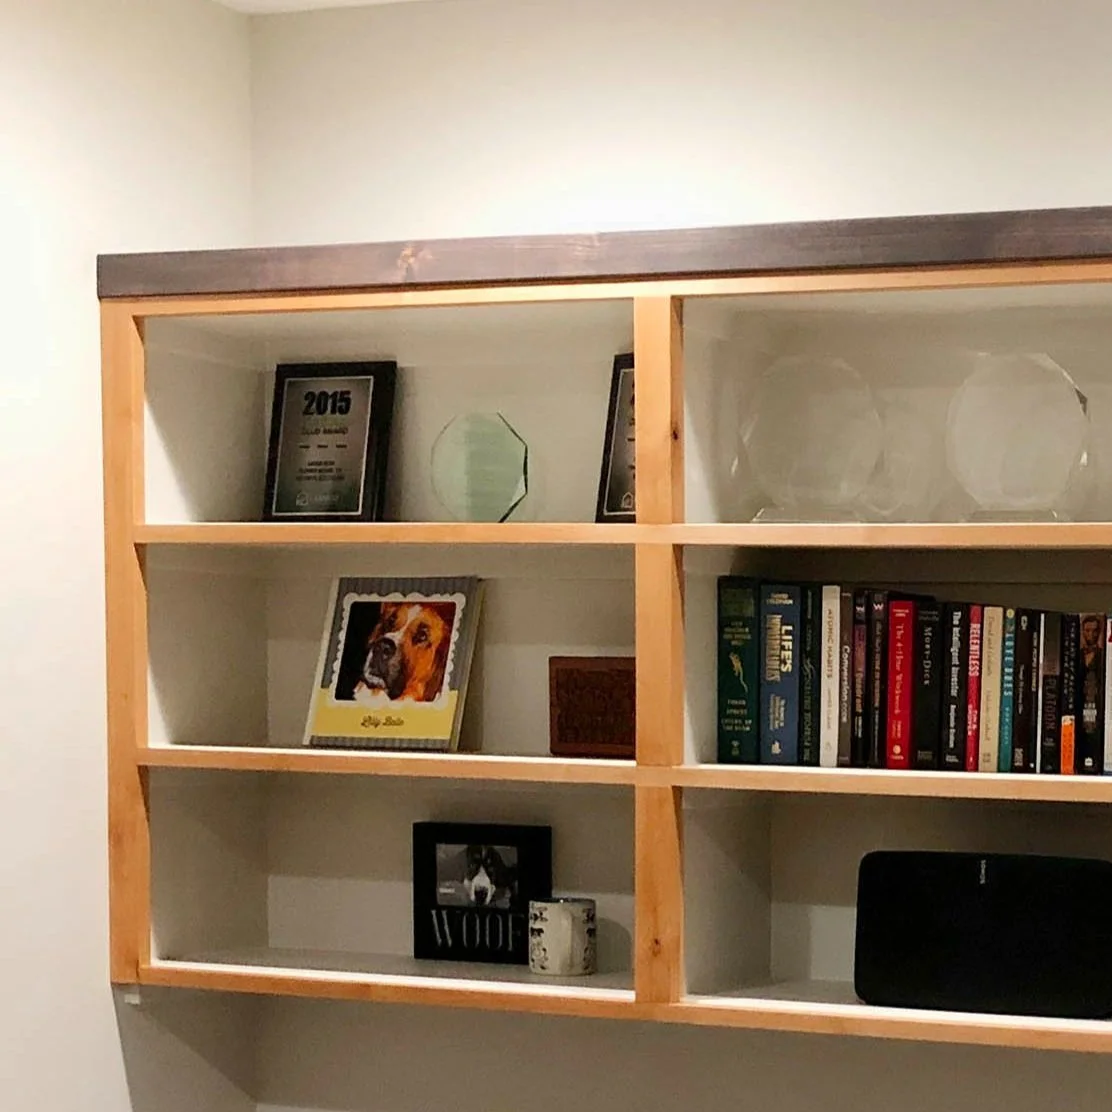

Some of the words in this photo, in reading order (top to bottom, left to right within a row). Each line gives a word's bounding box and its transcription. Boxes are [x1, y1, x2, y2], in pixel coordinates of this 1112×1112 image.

[303, 390, 352, 415] 2015
[826, 608, 834, 643] ATOMIC
[896, 623, 904, 640] The
[952, 611, 961, 626] The
[780, 625, 793, 673] LIFE'S
[826, 645, 834, 679] HABITS
[950, 627, 961, 665] Intelligent
[968, 623, 980, 677] RELENTLESS
[1004, 633, 1014, 662] LOVE
[841, 645, 851, 701] Conversion
[950, 667, 960, 697] Investor
[1003, 667, 1013, 697] DOES
[855, 672, 864, 712] Quadrant
[894, 673, 903, 715] Workweek
[431, 909, 526, 951] WOOF
